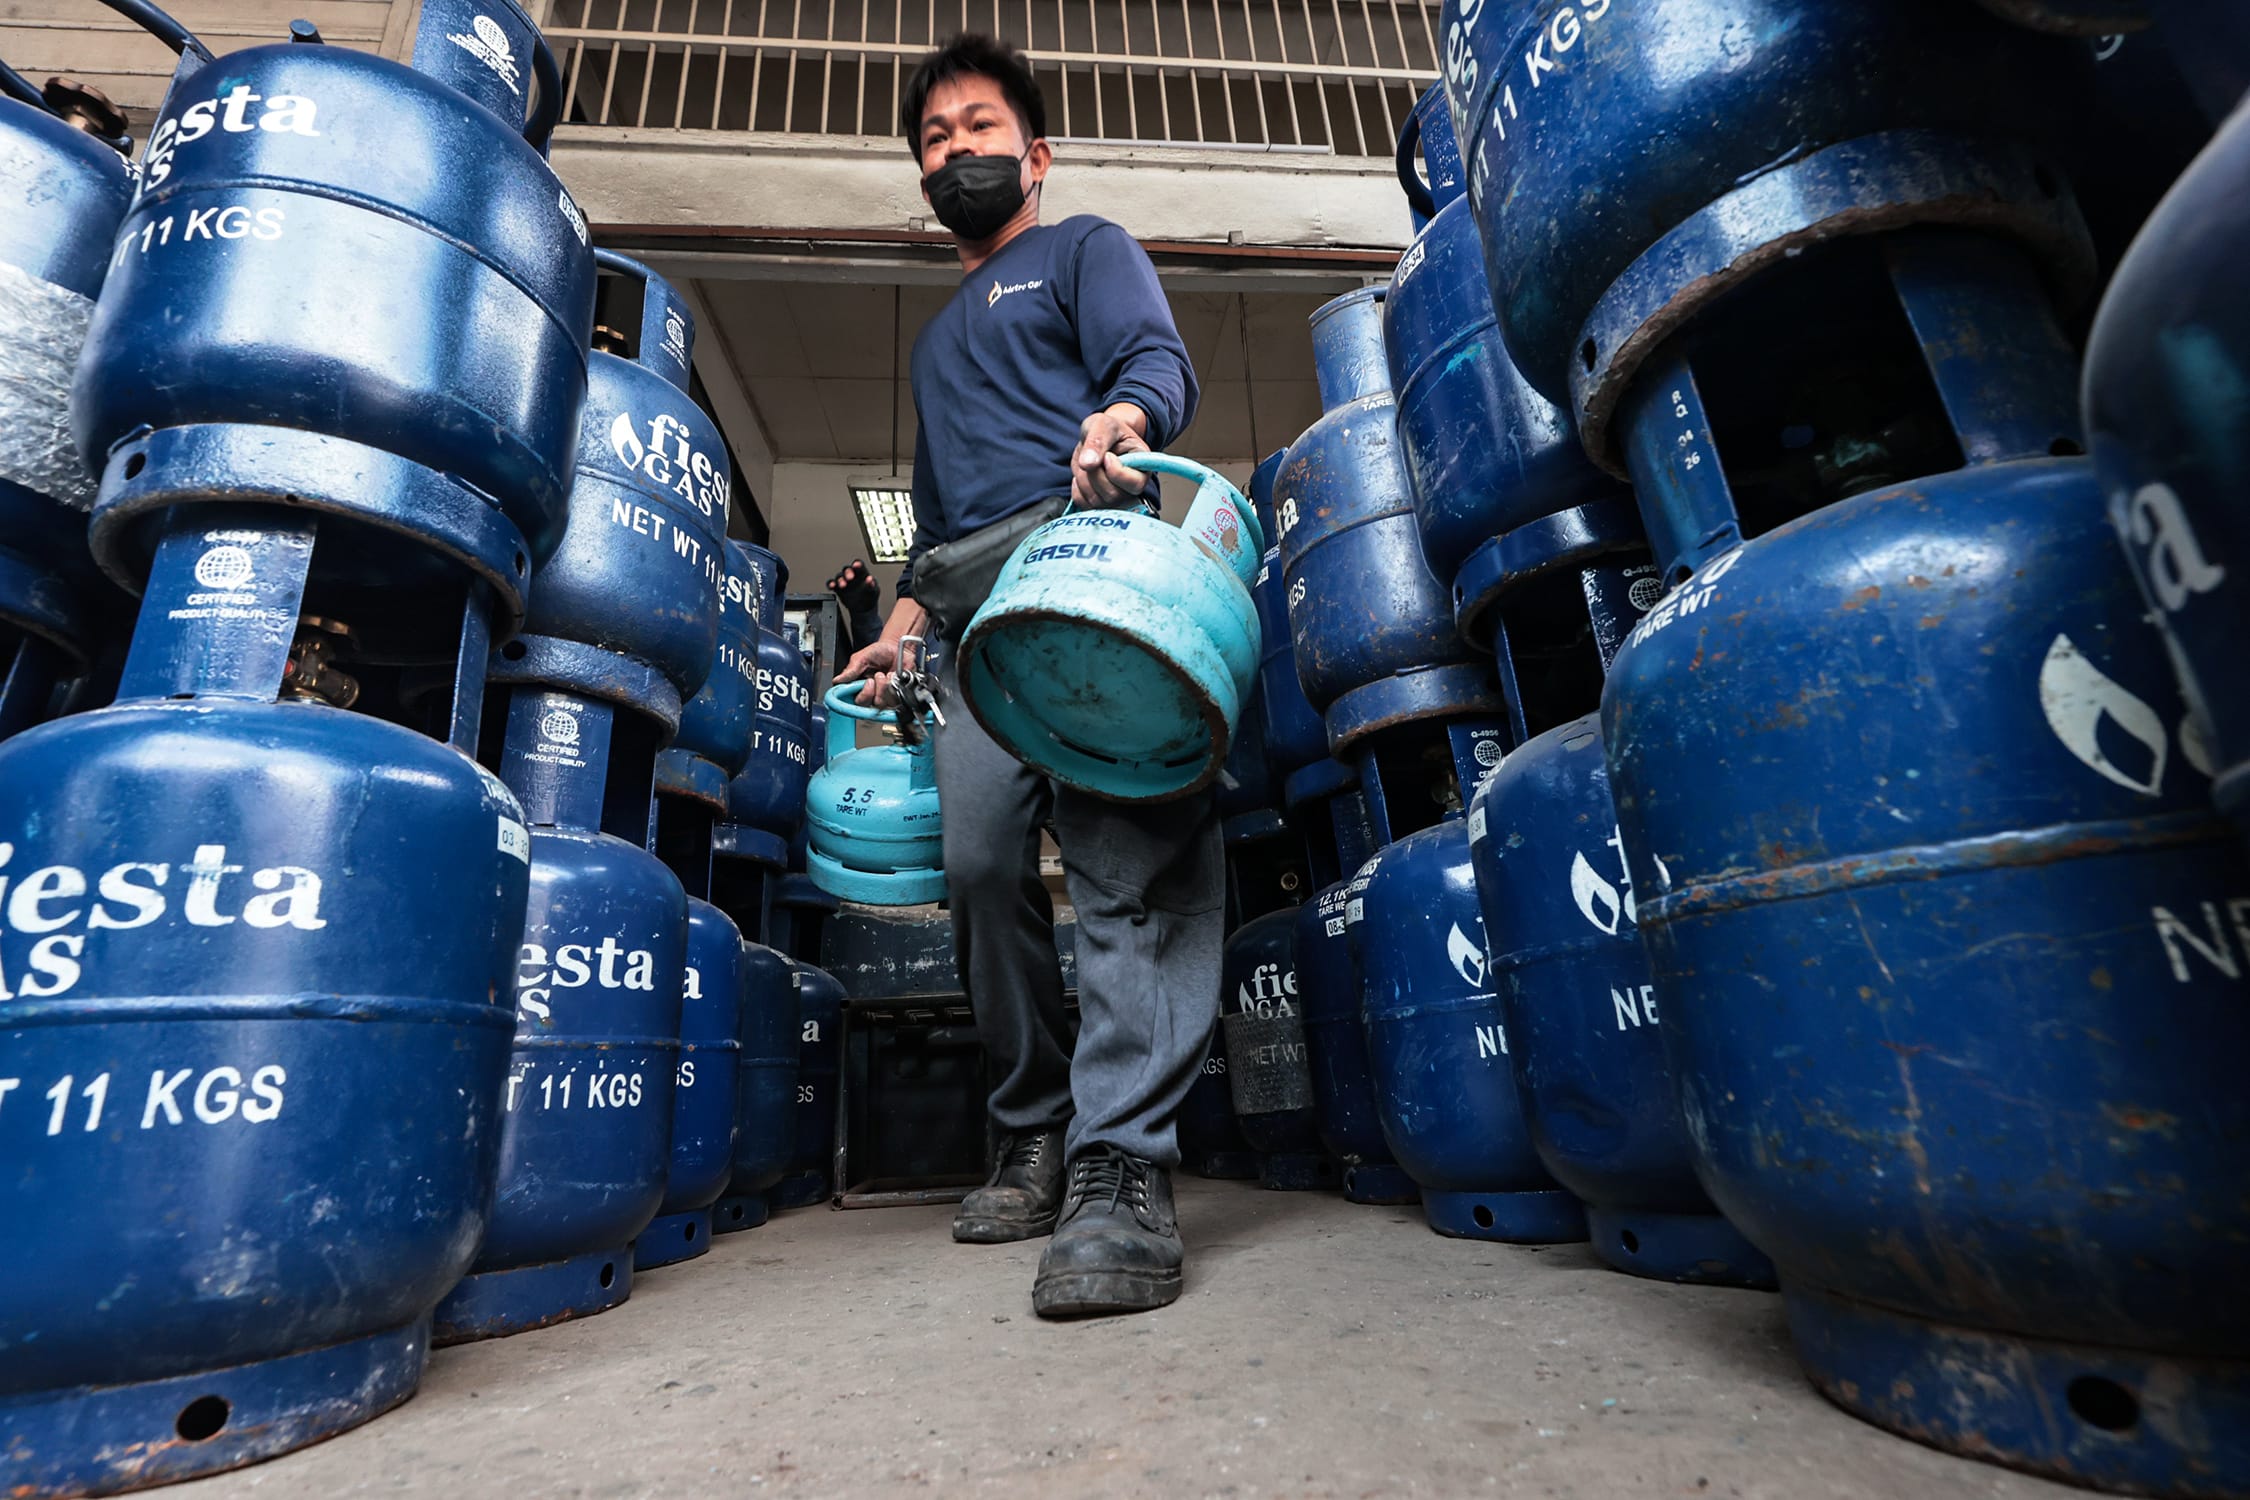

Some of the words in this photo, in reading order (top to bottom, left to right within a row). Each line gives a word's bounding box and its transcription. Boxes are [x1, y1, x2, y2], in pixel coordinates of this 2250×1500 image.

[1493, 84, 1518, 141] 11
[141, 216, 174, 253] 11
[183, 206, 285, 241] KGS
[644, 453, 712, 517] GAS
[612, 498, 665, 541] NET
[673, 526, 701, 565] WT
[1052, 517, 1131, 531] PETRON
[1023, 544, 1113, 565] GASUL
[186, 593, 257, 605] CERTIFIED
[1632, 604, 1678, 649] TARE
[1679, 584, 1718, 617] WT
[719, 644, 734, 668] 11
[768, 735, 782, 754] 11
[786, 741, 806, 765] KGS
[836, 804, 854, 815] TARE
[855, 808, 868, 817] WT
[1318, 903, 1334, 918] TARE
[46, 1074, 110, 1136] 11
[140, 1065, 287, 1129] KGS
[541, 1074, 571, 1110] 11
[588, 1073, 643, 1109] KGS
